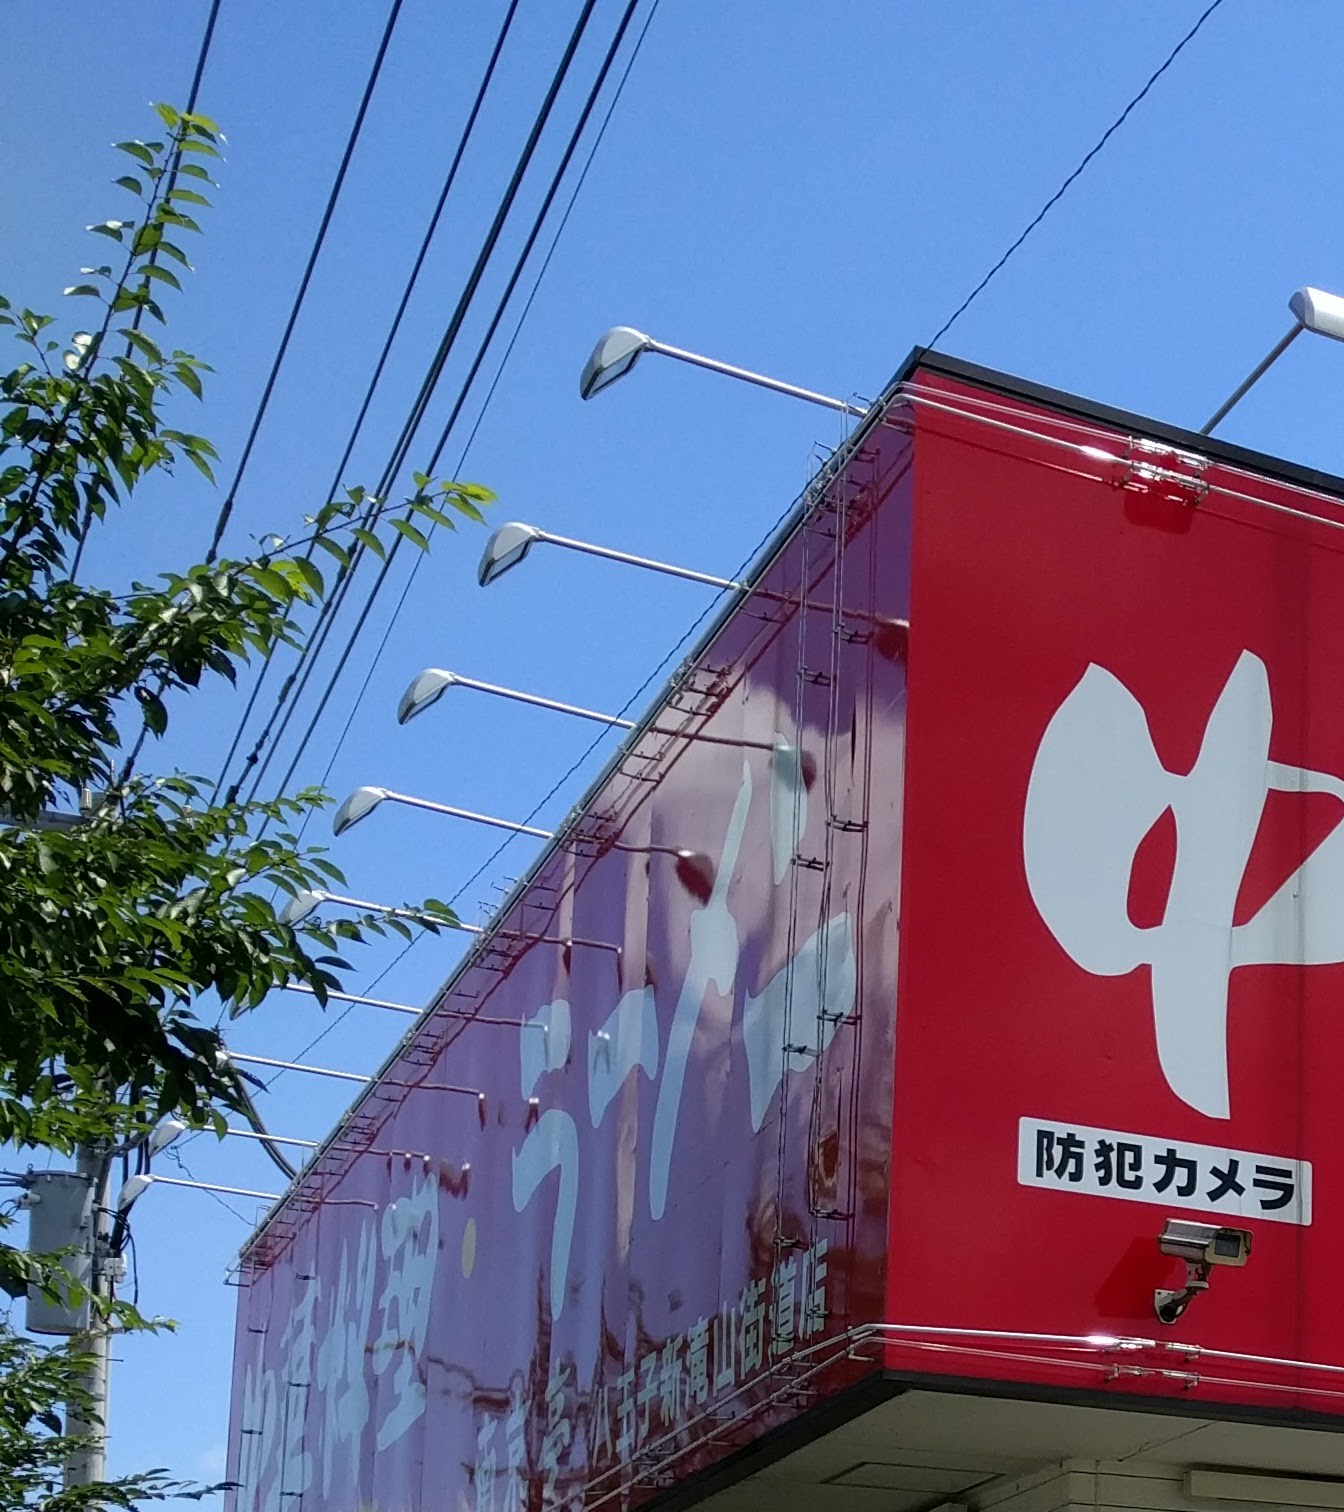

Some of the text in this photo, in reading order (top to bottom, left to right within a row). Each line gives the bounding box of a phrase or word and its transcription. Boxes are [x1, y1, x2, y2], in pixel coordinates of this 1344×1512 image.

[1034, 1130, 1294, 1206] 防犯カメラ
